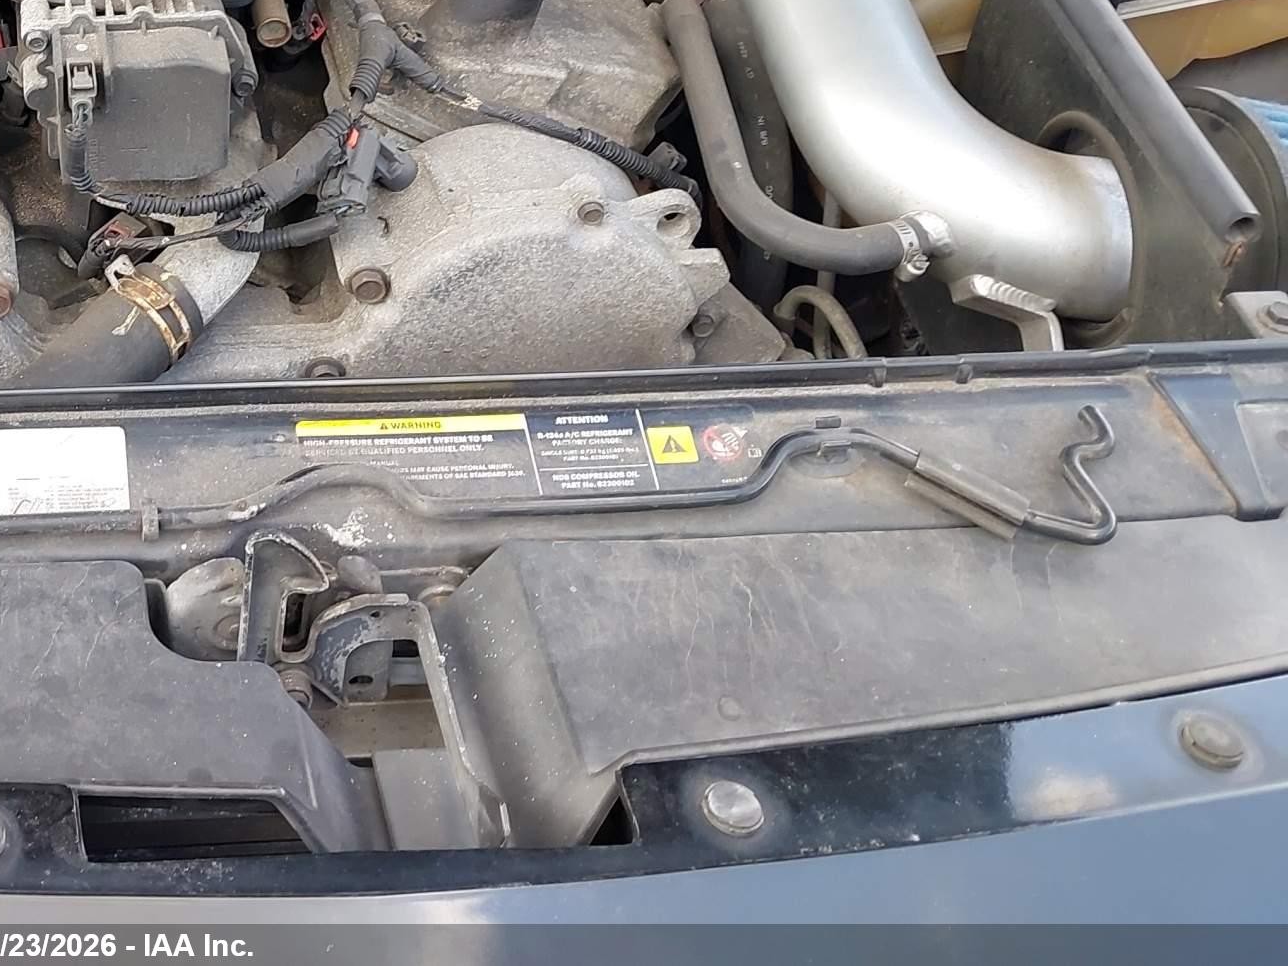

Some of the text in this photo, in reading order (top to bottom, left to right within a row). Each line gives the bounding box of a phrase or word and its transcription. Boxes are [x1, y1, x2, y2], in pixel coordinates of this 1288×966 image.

[555, 414, 609, 425] ATTENTION
[390, 420, 442, 430] WARNING
[581, 428, 634, 438] REFRIGERANT
[374, 436, 432, 446] REFRIGERANT
[433, 435, 468, 444] SYSTEM
[469, 435, 480, 444] TO
[360, 445, 406, 455] QUALIFIED
[407, 444, 459, 454] PERSONNEL
[460, 443, 485, 452] ONLY.
[426, 465, 449, 473] CAUSE
[570, 471, 625, 480] COMPRESSOR
[561, 481, 581, 489] PART
